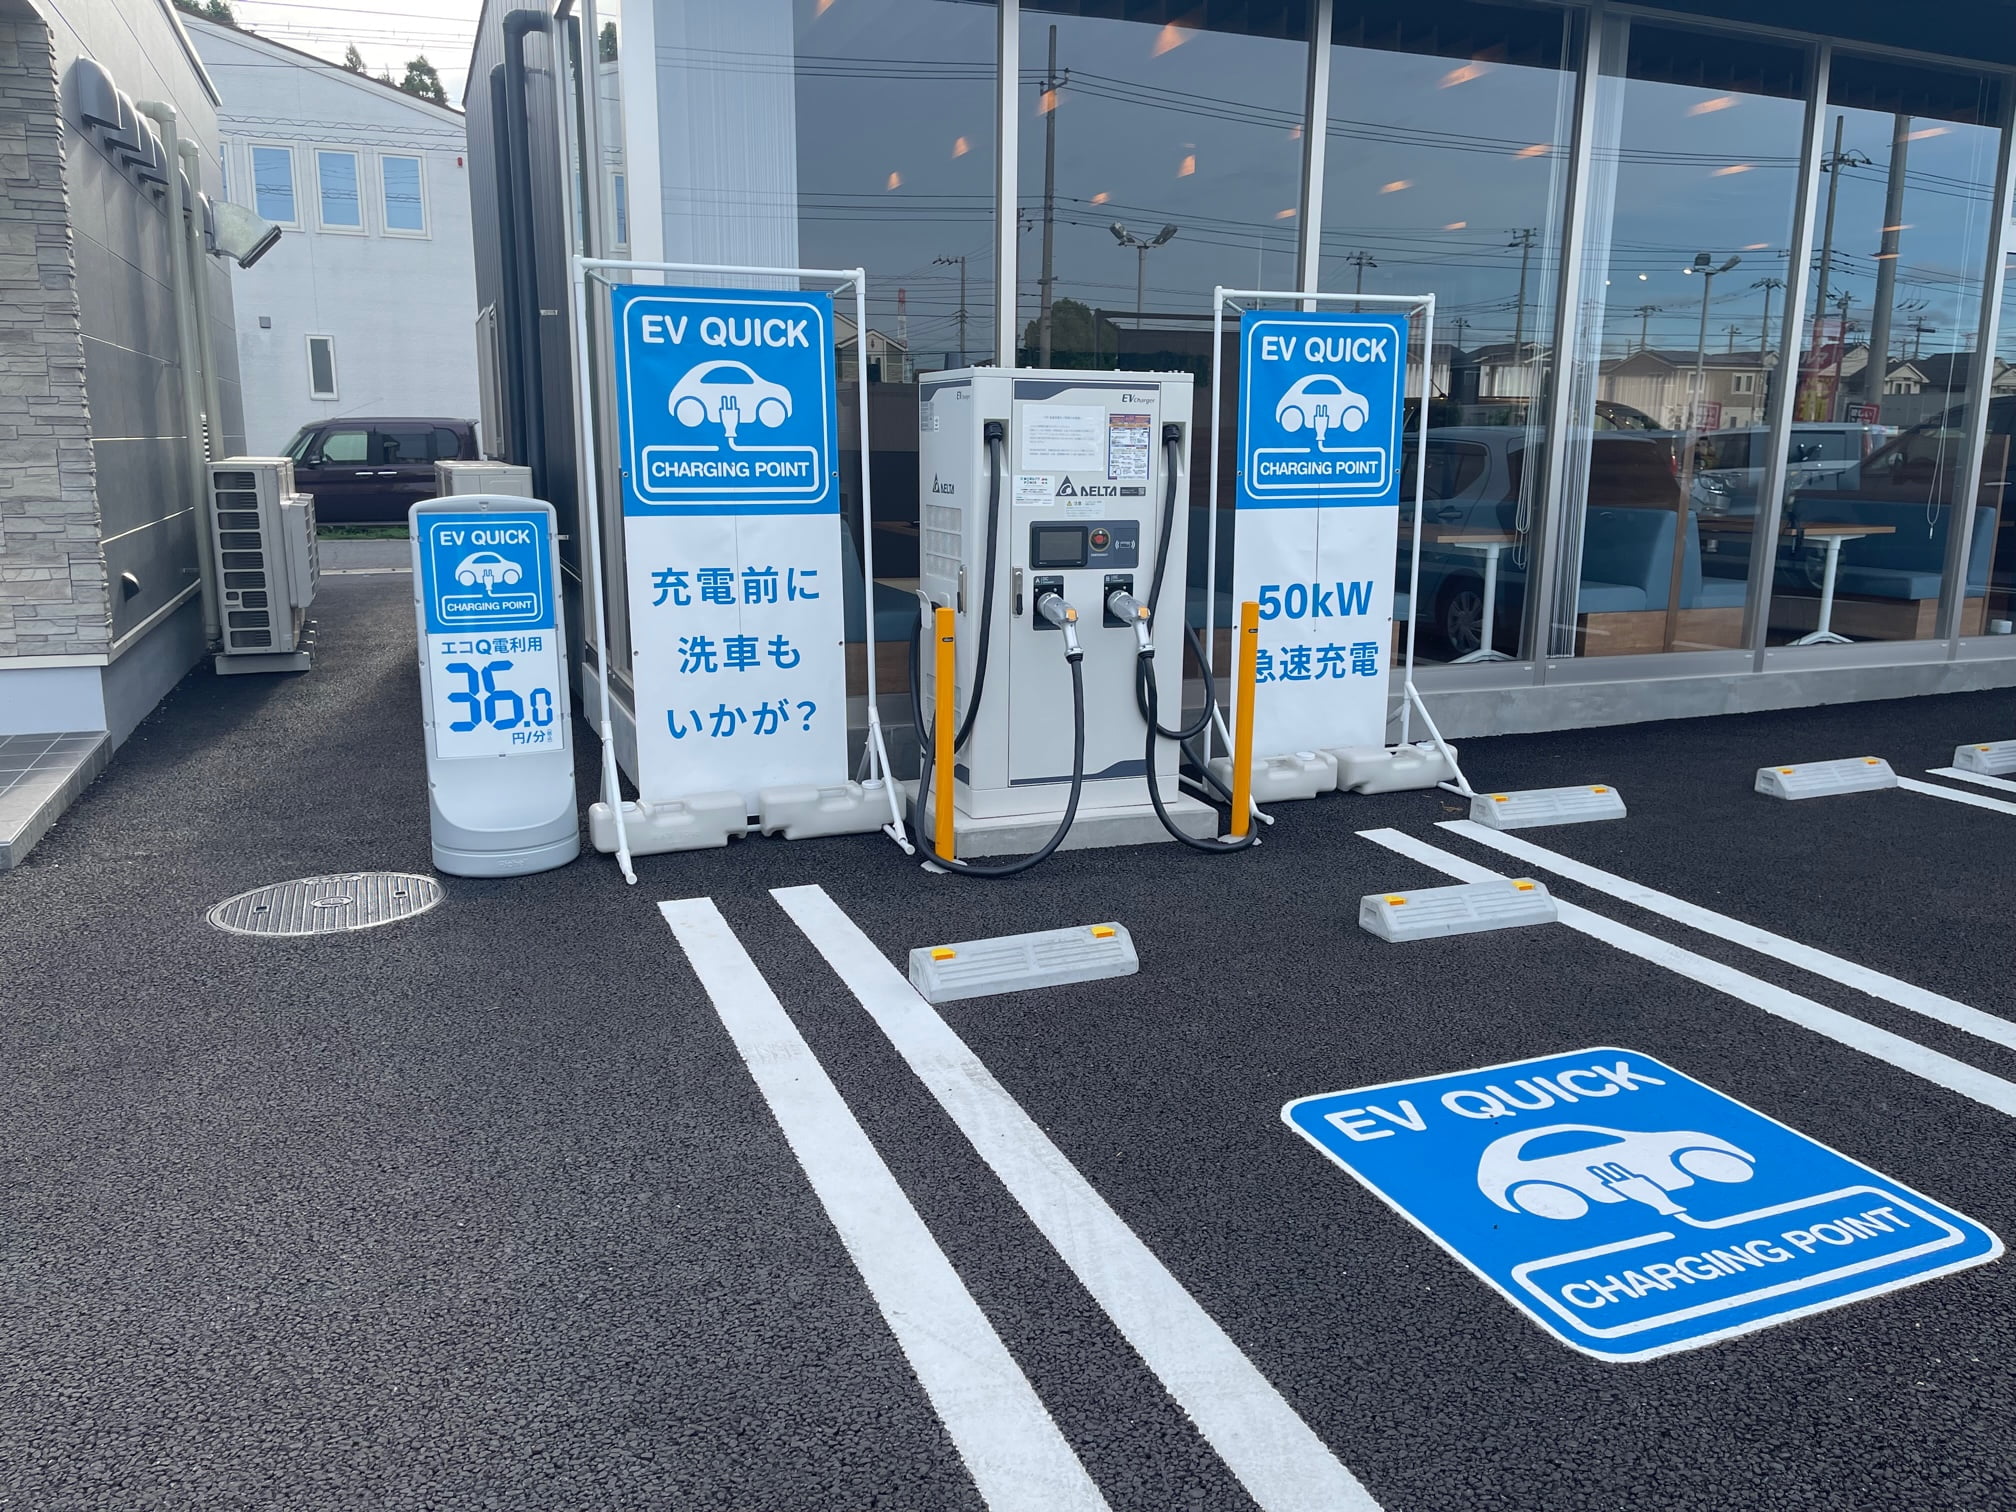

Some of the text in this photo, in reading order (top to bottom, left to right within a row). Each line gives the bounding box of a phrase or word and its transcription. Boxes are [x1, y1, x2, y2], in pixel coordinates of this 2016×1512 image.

[642, 315, 810, 347] EV QUICK
[1262, 336, 1387, 362] EV QUICK
[651, 462, 810, 477] CHARGING POINT
[1260, 460, 1378, 476] CHARGING POINT
[1081, 486, 1117, 496] DELTA
[440, 530, 530, 546] EV QUICK
[652, 566, 819, 606] 充電前に
[1259, 581, 1374, 620] 50kW
[447, 600, 532, 612] CHARGING POINT
[441, 637, 543, 655] エコQ電利用
[678, 635, 801, 673] 洗車も
[446, 660, 554, 732] 36.0
[668, 699, 817, 740] いかが？
[512, 730, 546, 745] 円/分
[1323, 1061, 1666, 1142] EV QUICK
[1560, 1207, 1911, 1309] CHARGING POINT
